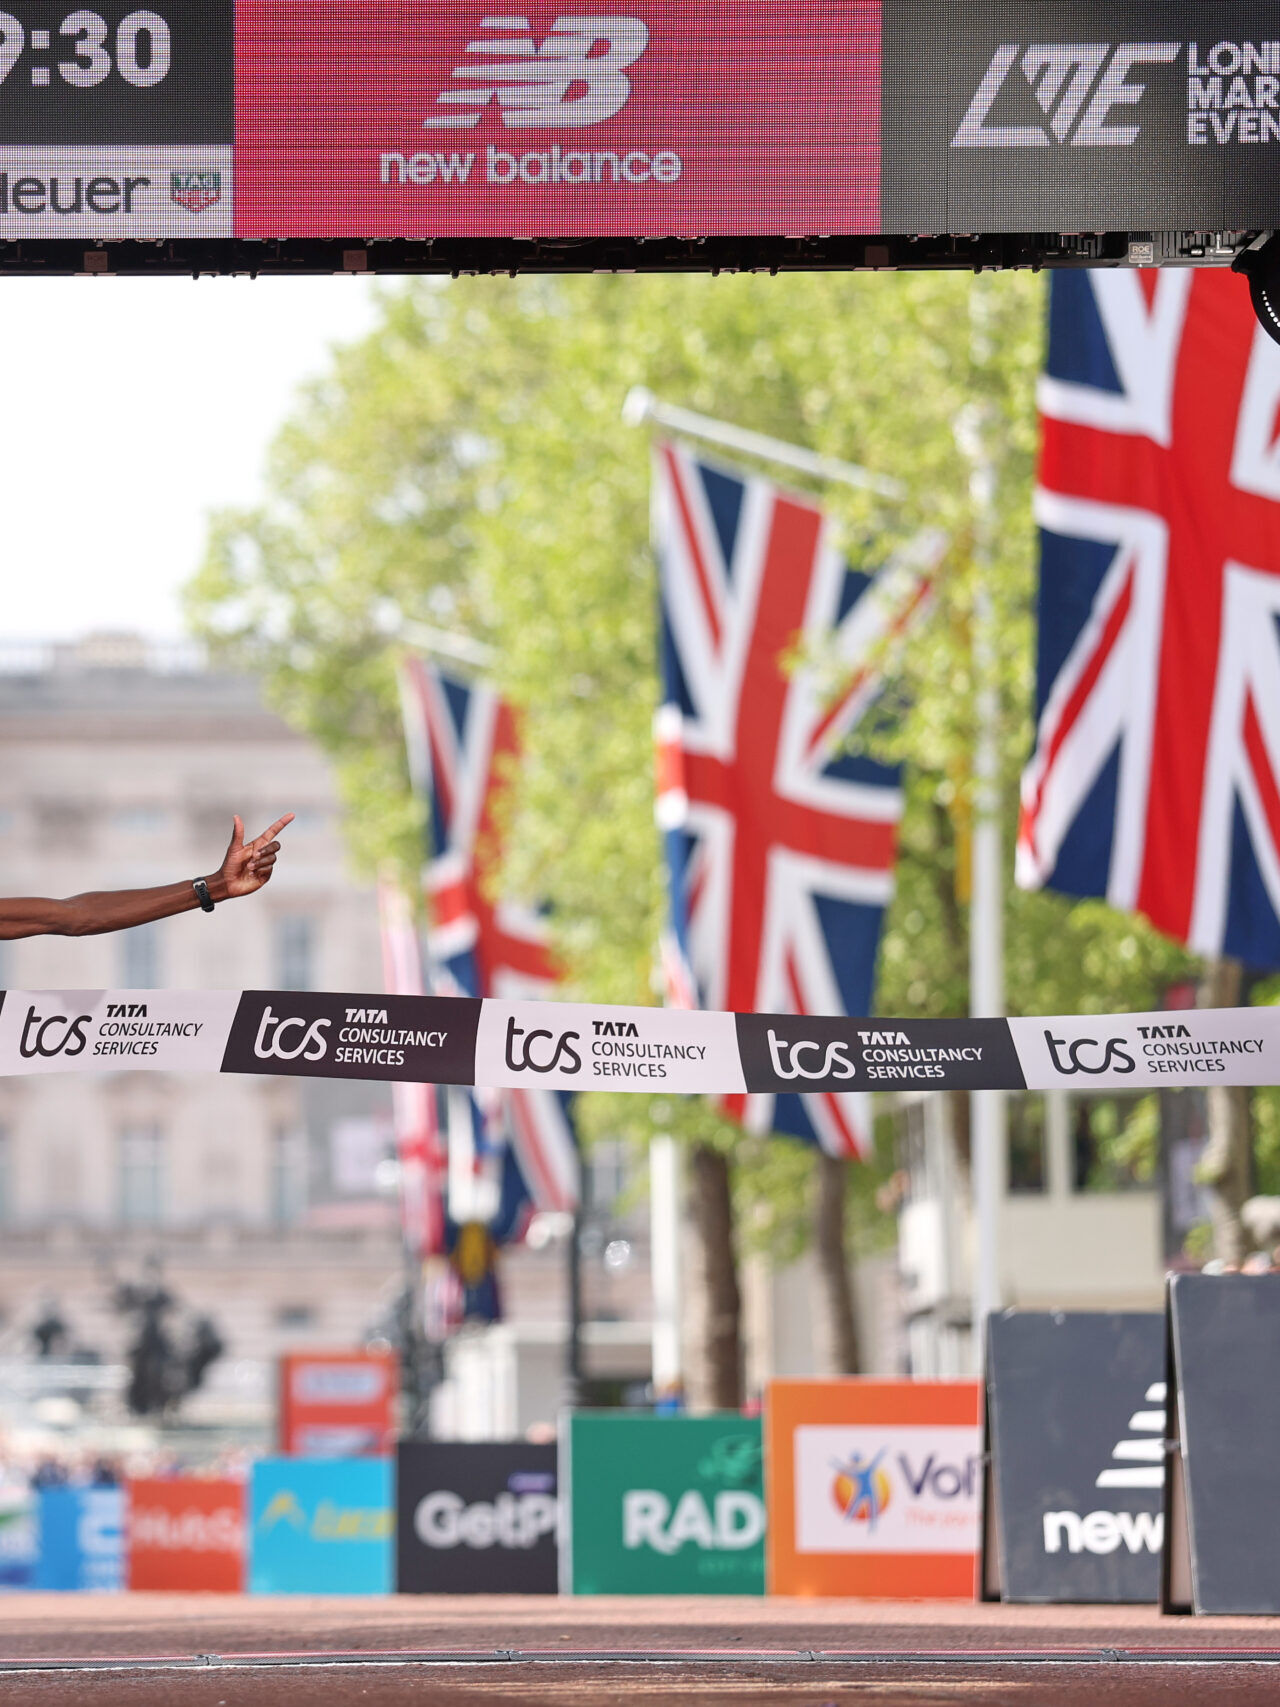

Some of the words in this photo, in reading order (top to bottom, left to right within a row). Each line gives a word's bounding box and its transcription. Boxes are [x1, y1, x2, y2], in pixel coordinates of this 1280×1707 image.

[1187, 41, 1280, 75] LON
[1187, 76, 1280, 109] MAR
[379, 151, 477, 185] new
[485, 144, 684, 185] balance
[106, 1004, 148, 1018] TATA
[344, 1008, 388, 1025] TATA
[20, 1005, 93, 1058] tcs
[98, 1022, 203, 1037] CONSULTANCY
[253, 1005, 332, 1062] tcs
[338, 1027, 448, 1048] CONSULTANCY
[592, 1020, 639, 1038] TATA
[857, 1031, 911, 1045] TATA
[1136, 1024, 1191, 1039] TATA
[92, 1041, 159, 1056] SERVICES
[505, 1016, 582, 1074] tcs
[591, 1041, 707, 1060] CONSULTANCY
[767, 1029, 856, 1080] tcs
[1043, 1029, 1136, 1075] tcs
[1142, 1039, 1264, 1056] CONSULTANCY
[334, 1047, 405, 1066] SERVICES
[862, 1047, 983, 1063] CONSULTANCY
[592, 1061, 667, 1078] SERVICES
[866, 1065, 945, 1079] SERVICES
[1147, 1058, 1226, 1073] SERVICES
[414, 1489, 562, 1550] GetP
[622, 1488, 768, 1555] RAD
[1043, 1510, 1165, 1555] new
